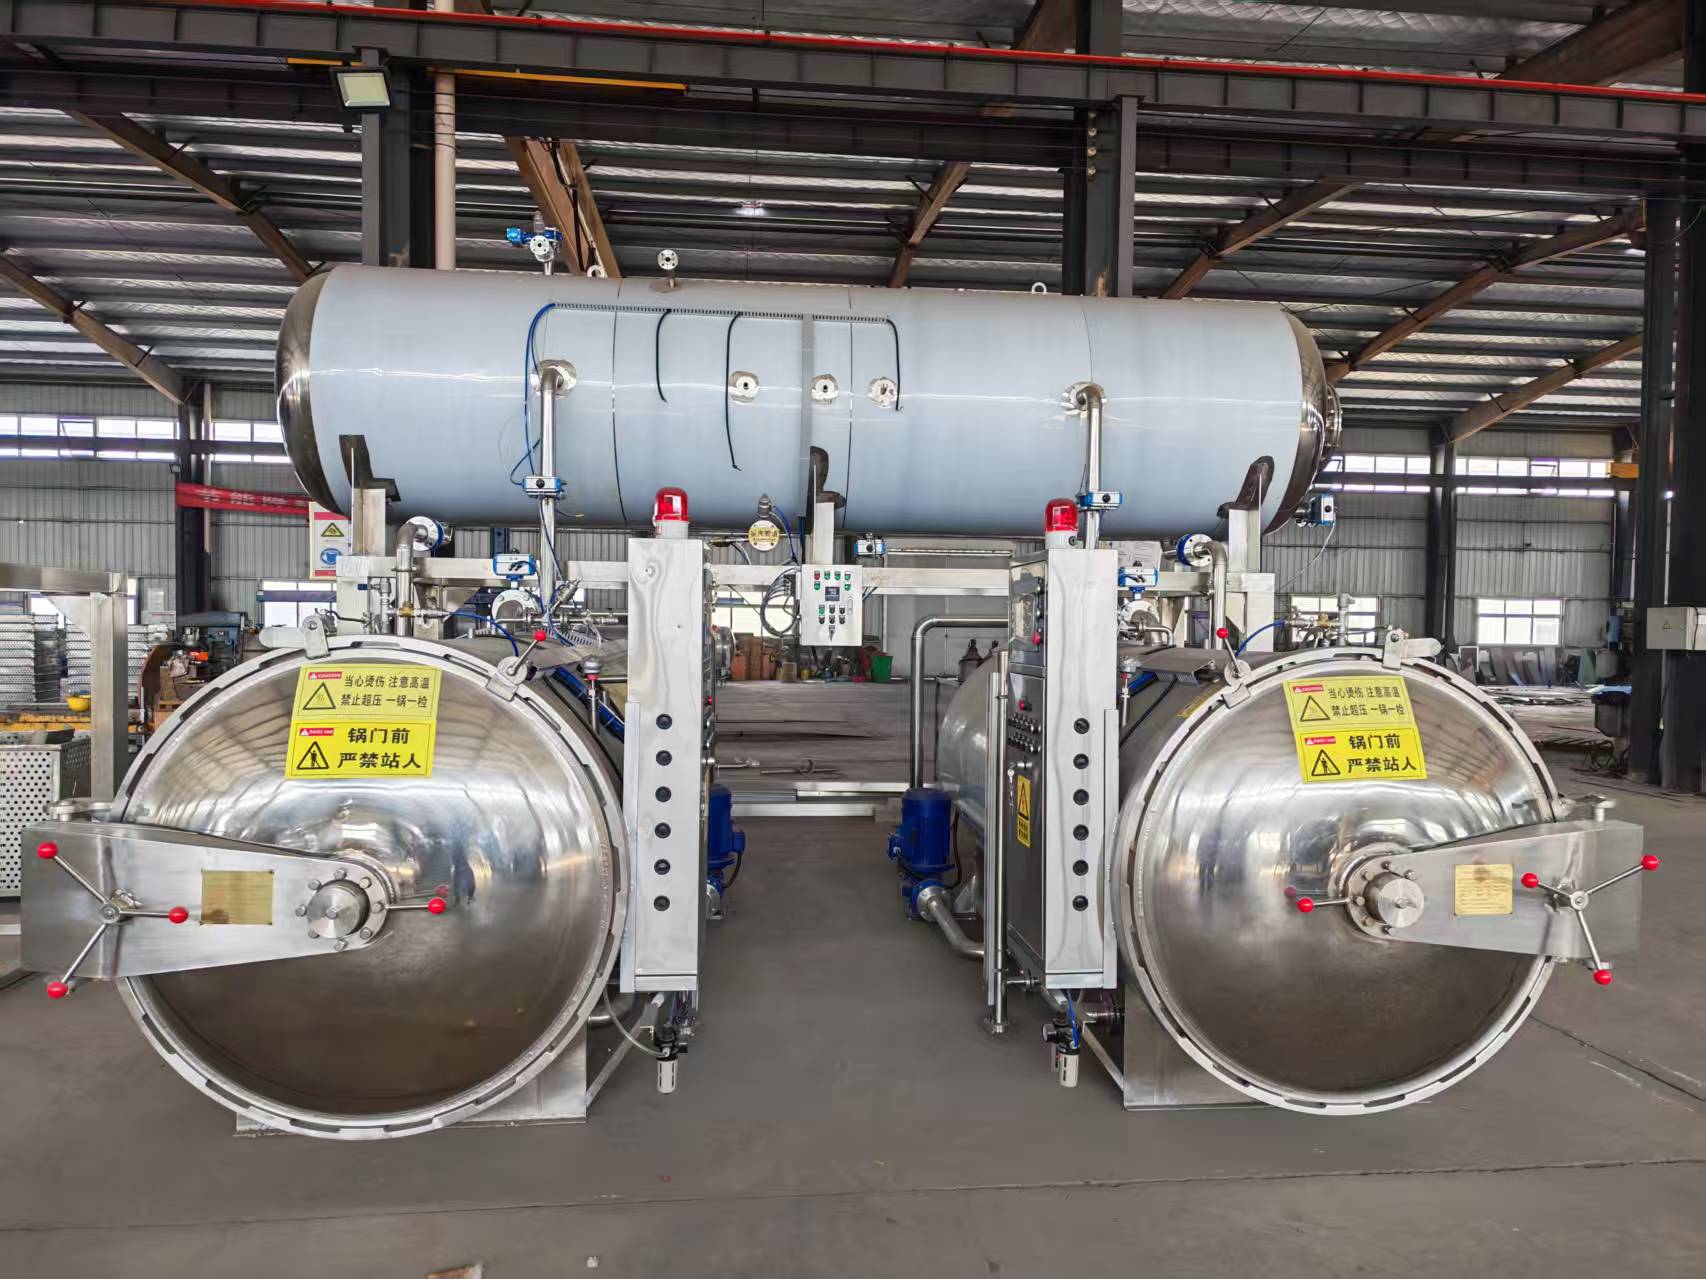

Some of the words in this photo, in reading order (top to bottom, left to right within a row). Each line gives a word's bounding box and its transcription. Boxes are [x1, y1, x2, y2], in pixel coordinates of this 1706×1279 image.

[344, 676, 384, 688] 当心烫伤
[388, 677, 429, 689] 注意高温
[340, 694, 382, 707] 禁止超压
[385, 695, 428, 708] 一锅一检
[1332, 704, 1368, 716] 禁止超压
[348, 727, 410, 744] 锅门前
[1349, 734, 1400, 750] 锅门前
[337, 752, 421, 769] 严禁站人
[1347, 757, 1417, 773] 严禁站人
